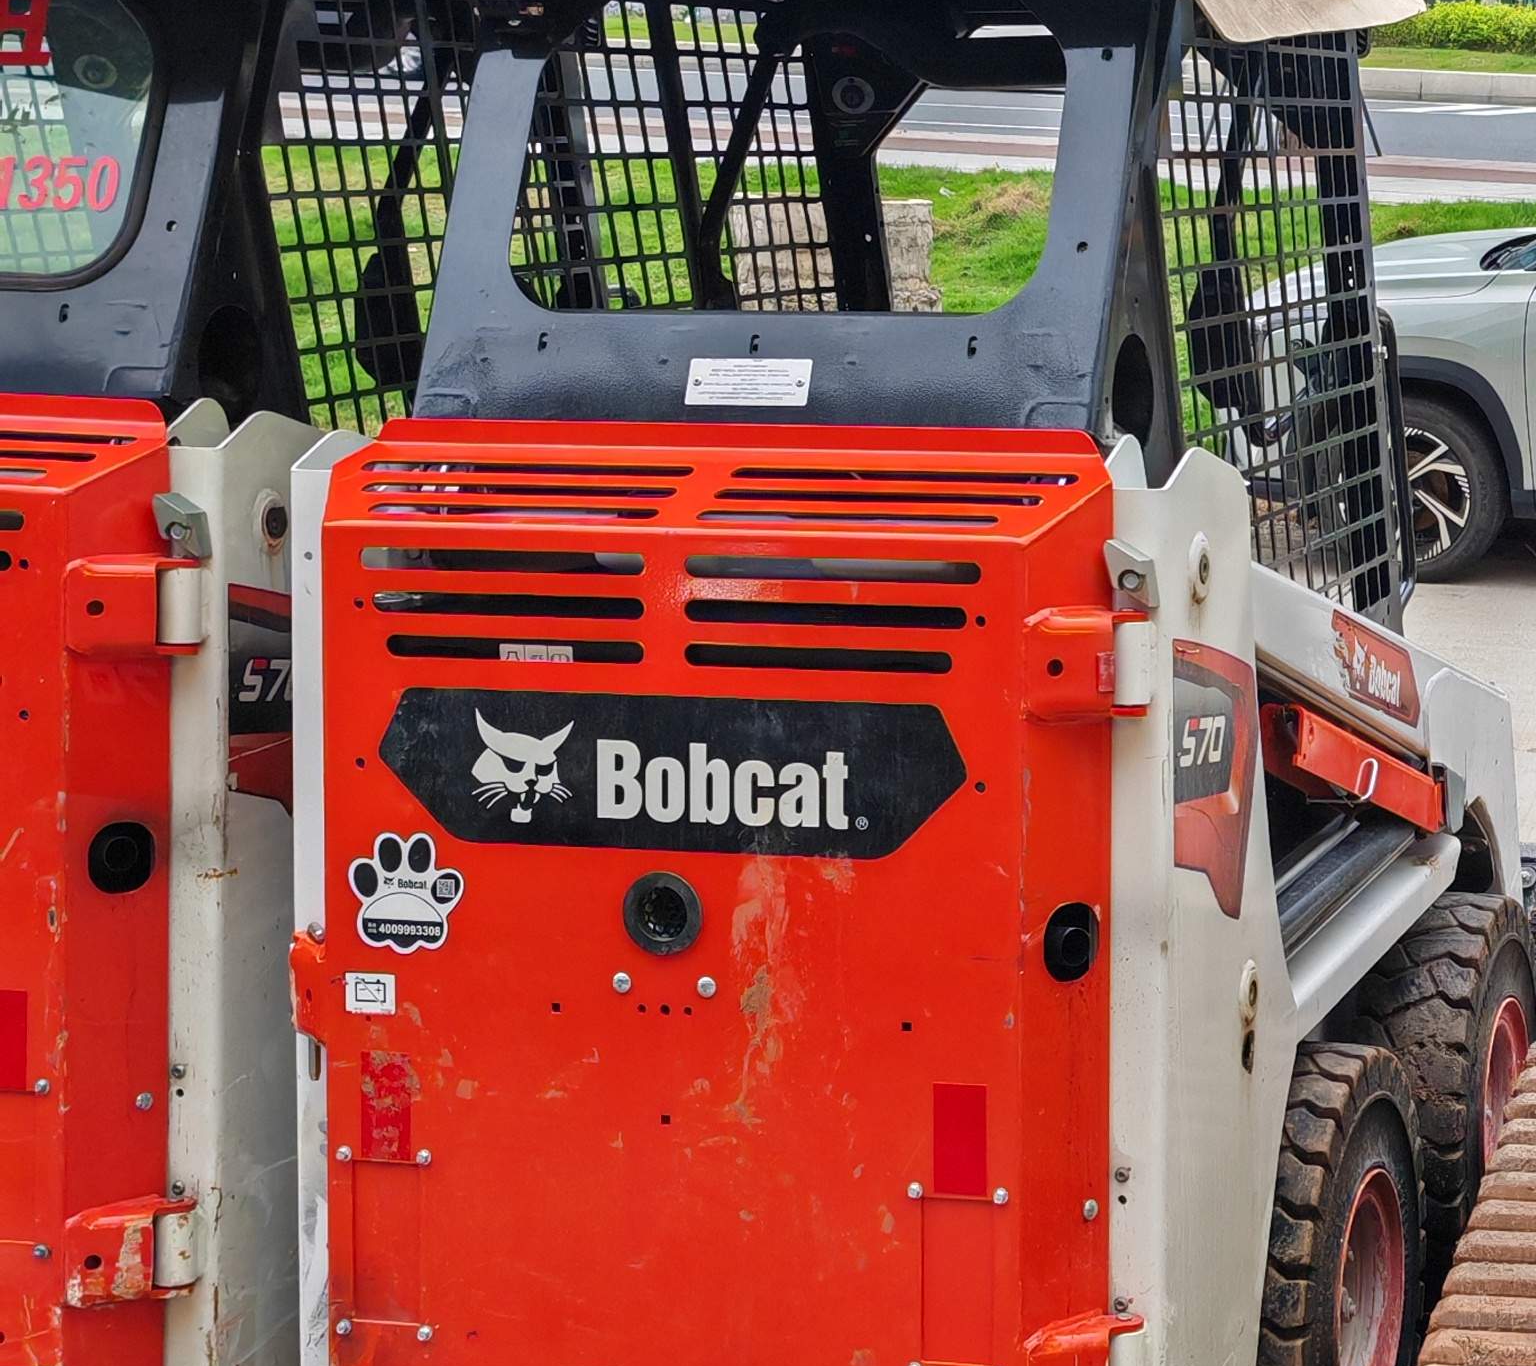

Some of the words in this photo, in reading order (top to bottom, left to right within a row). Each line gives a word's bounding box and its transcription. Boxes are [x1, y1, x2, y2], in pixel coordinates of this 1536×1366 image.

[1180, 716, 1226, 767] S70
[597, 738, 849, 830] Bobcat
[397, 878, 428, 890] Bobcat
